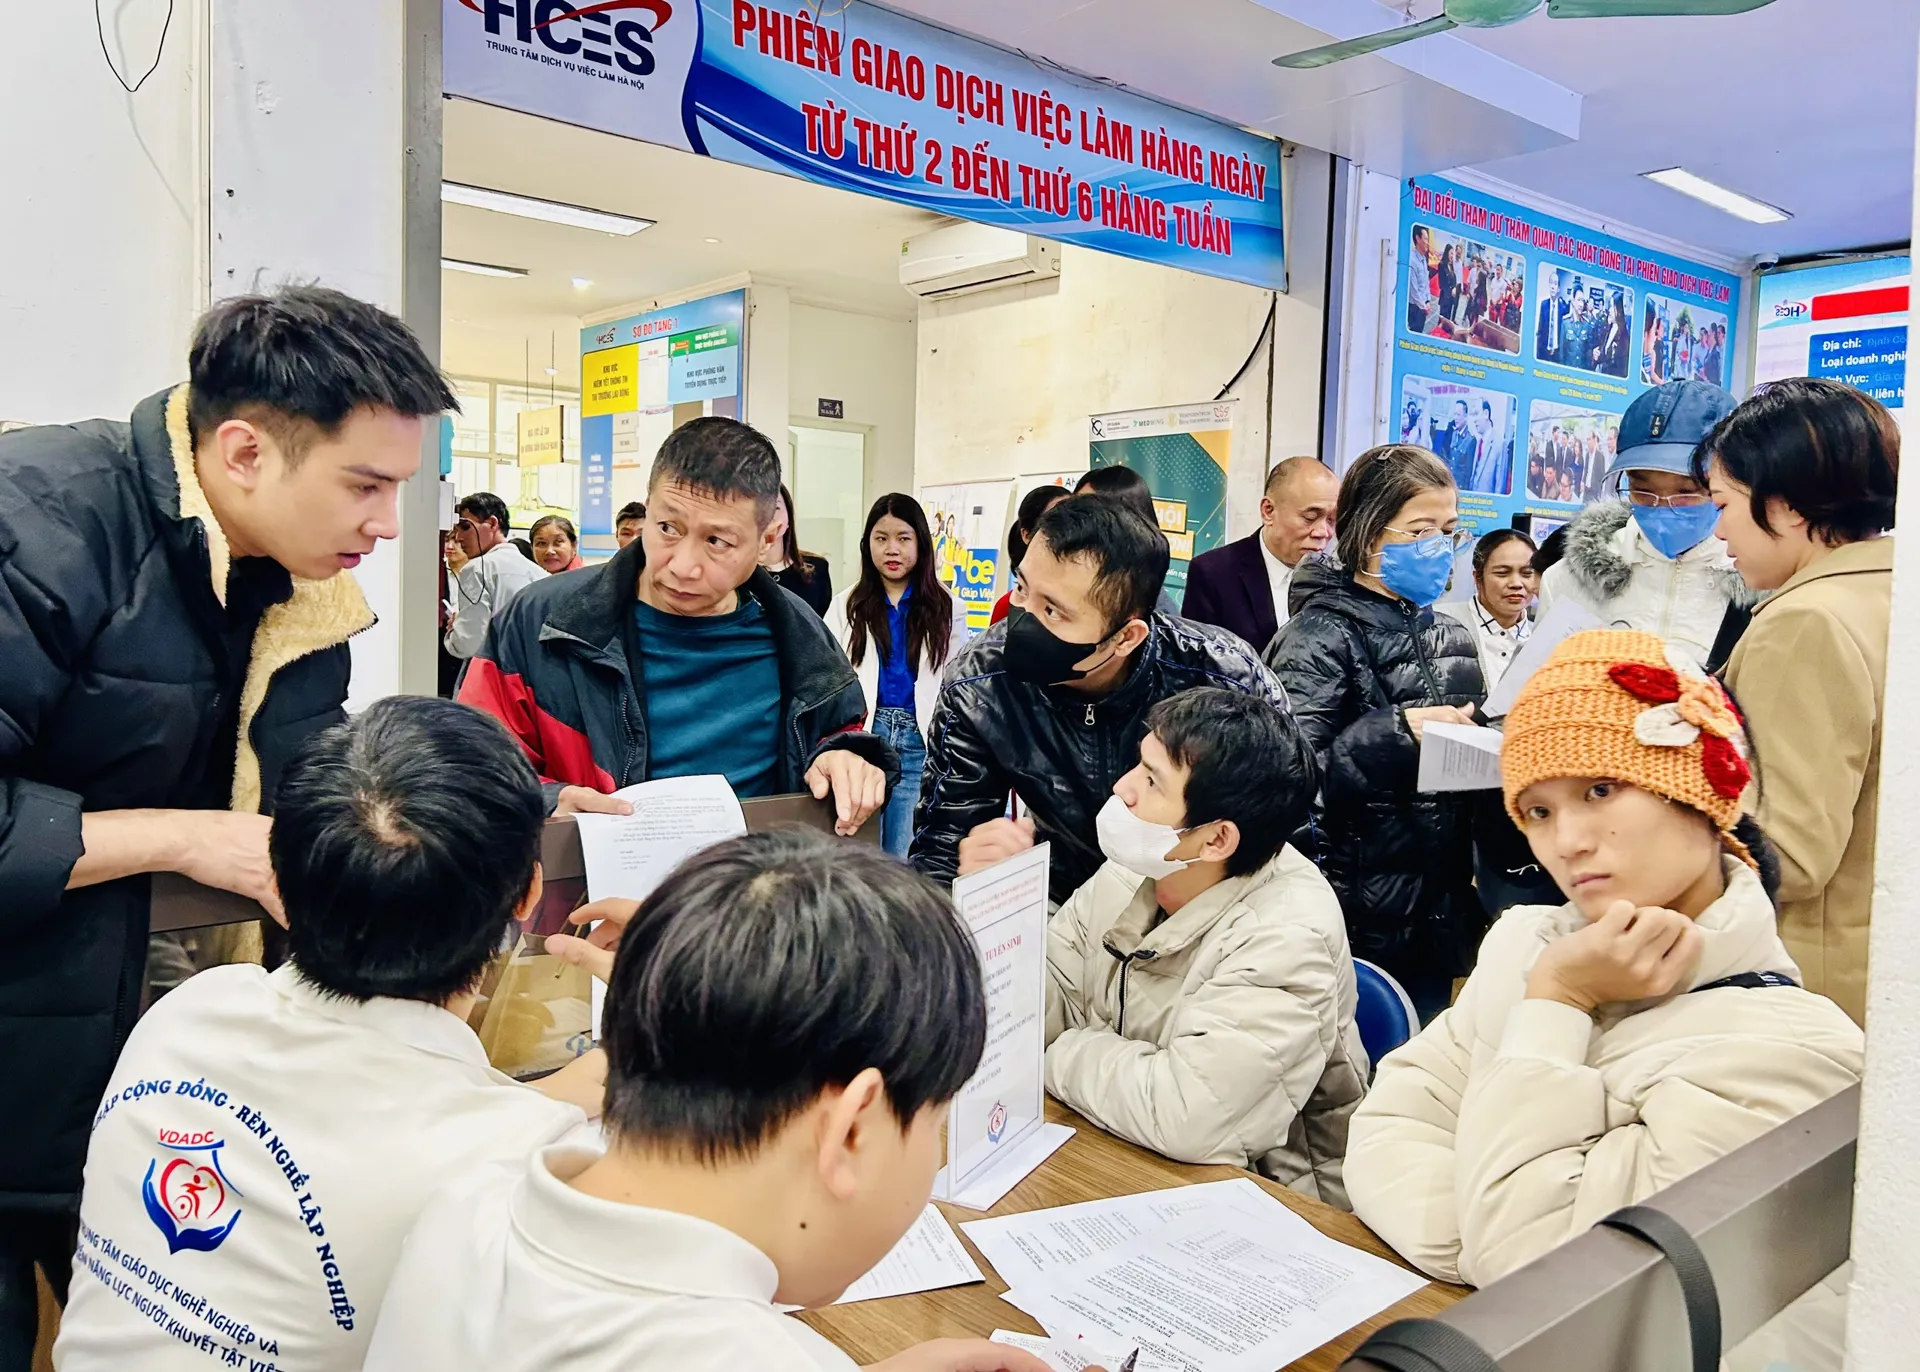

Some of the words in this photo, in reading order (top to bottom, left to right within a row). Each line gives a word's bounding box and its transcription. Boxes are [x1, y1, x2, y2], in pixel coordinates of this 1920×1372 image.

[486, 40, 518, 55] TRUNG
[520, 47, 539, 62] TÂM
[541, 54, 562, 68] DỊCH
[564, 60, 576, 73] VỤ
[577, 64, 597, 77] VIỆC
[598, 68, 616, 82] LÀM
[617, 73, 629, 85] HÀ
[630, 79, 645, 90] NỘI
[732, 0, 841, 76] PHIÊN
[852, 38, 925, 101] GIAO
[935, 64, 1004, 125] DỊCH
[1012, 90, 1072, 150] VIỆC
[1080, 106, 1134, 164] LÀM
[1140, 126, 1204, 184] HÀNG
[1209, 152, 1267, 201] NGÀY
[801, 99, 847, 159] TỪ
[853, 122, 917, 176] THỨ
[924, 140, 943, 185] 2
[951, 141, 1011, 202] ĐẾN
[1018, 166, 1072, 217] THỨ
[1077, 182, 1093, 222] 6
[1100, 182, 1168, 242] HÀNG
[1173, 200, 1233, 257] TUẦN
[1414, 186, 1432, 215] ĐẠI
[1435, 190, 1457, 219] BIỂU
[1460, 201, 1487, 229] THAM
[1490, 212, 1504, 238] DỰ
[1532, 226, 1556, 251] QUAN
[1557, 232, 1574, 258] CÁC
[1576, 240, 1597, 267] HOẠT
[1623, 255, 1635, 280] TẠI
[1661, 267, 1678, 288] GIAO
[1680, 273, 1697, 296] DỊCH
[1821, 355, 1843, 368] Loại
[1846, 353, 1878, 366] doanh
[1823, 341, 1840, 351] Địa
[1842, 337, 1862, 349] chỉ:
[1845, 374, 1869, 385] Vực:
[1876, 388, 1894, 399] liên
[1064, 477, 1079, 487] Ah
[966, 550, 995, 585] be
[961, 587, 978, 600] Giúp
[160, 1128, 214, 1145] VDADC
[122, 1080, 171, 1101] CỘNG
[175, 1077, 228, 1107] ĐỒNG
[235, 1104, 272, 1139] RÈN
[265, 1135, 310, 1192] NGHỀ
[298, 1192, 325, 1237] LẬP
[316, 1242, 355, 1331] NGHIỆP
[88, 1257, 112, 1286] NĂNG
[112, 1276, 133, 1301] LỰC
[132, 1291, 169, 1328] NGƯỜI
[165, 1318, 218, 1355] KHUYẾT
[220, 1346, 247, 1368] TẬT
[101, 1238, 121, 1262] TÂM
[121, 1253, 148, 1279] GIÁO
[147, 1270, 173, 1295] DỤC
[171, 1286, 207, 1317] NGHỀ
[204, 1308, 256, 1345] NGHIỆP
[259, 1337, 279, 1357] VÀ
